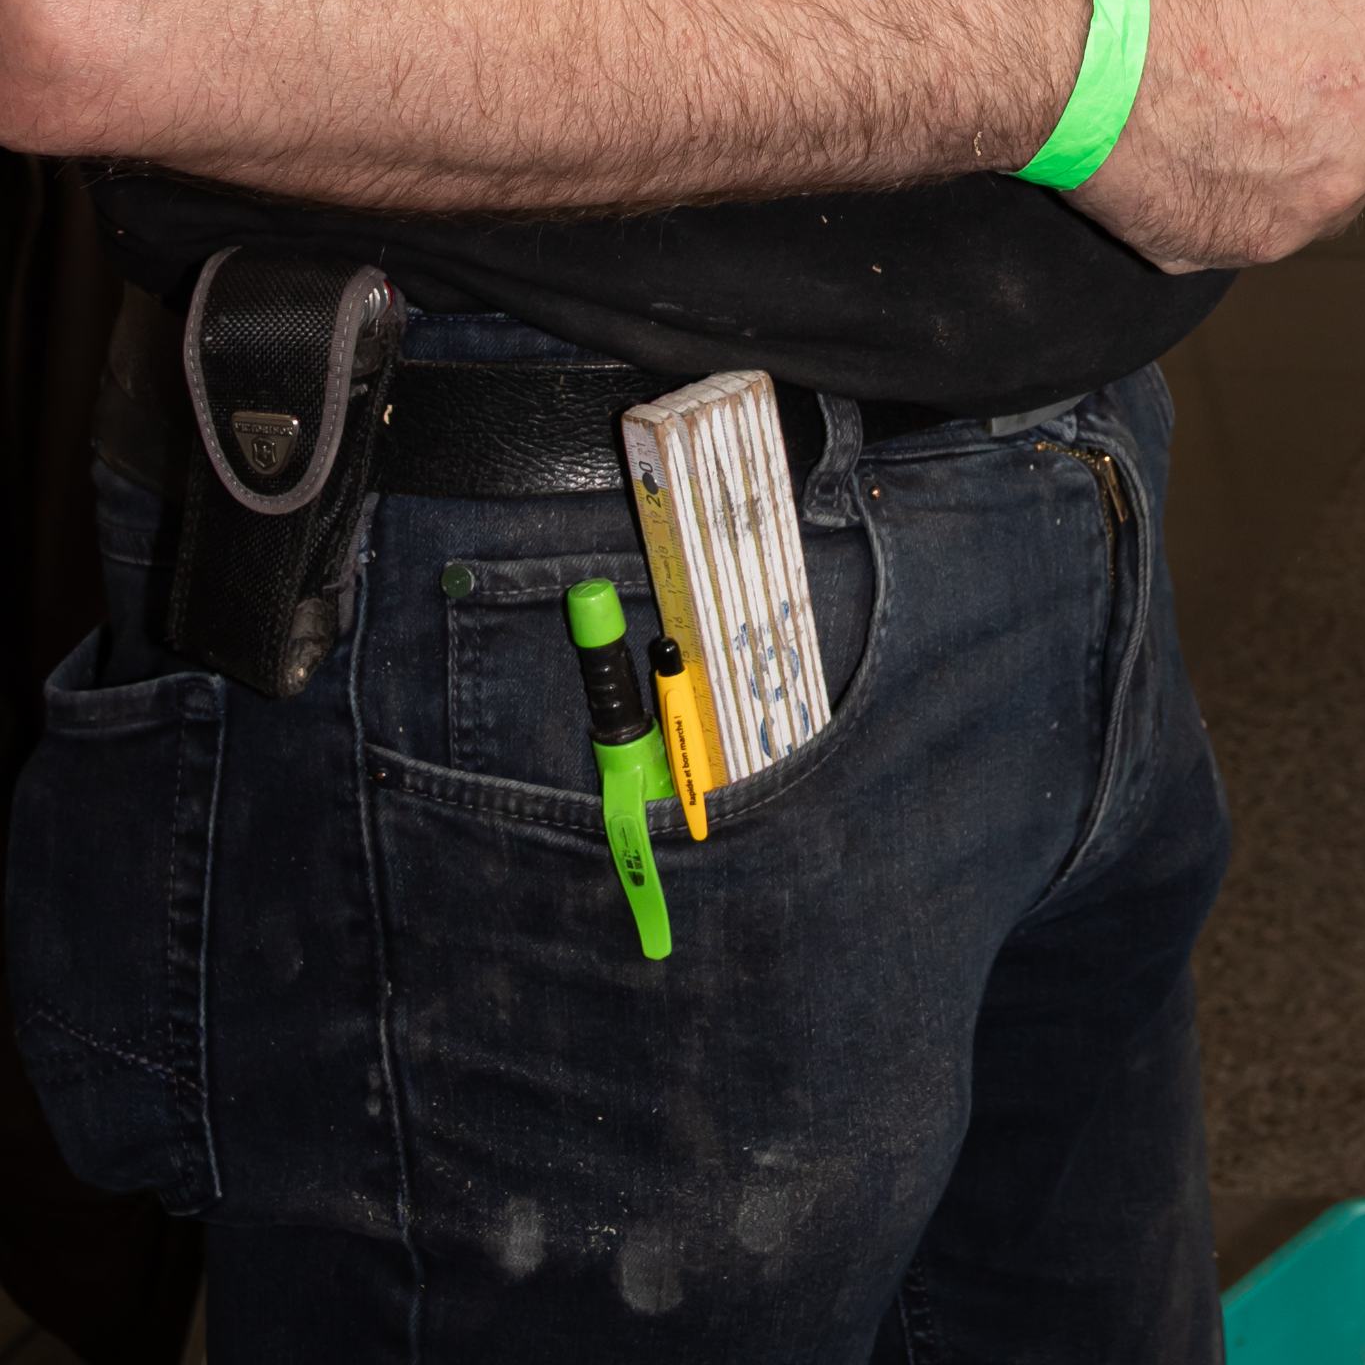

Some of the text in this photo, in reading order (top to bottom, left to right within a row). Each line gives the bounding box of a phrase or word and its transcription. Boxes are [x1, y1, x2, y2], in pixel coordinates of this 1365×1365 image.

[675, 720, 687, 751] marché
[681, 752, 690, 769] bon
[684, 769, 692, 778] et
[686, 779, 696, 805] Rapide
